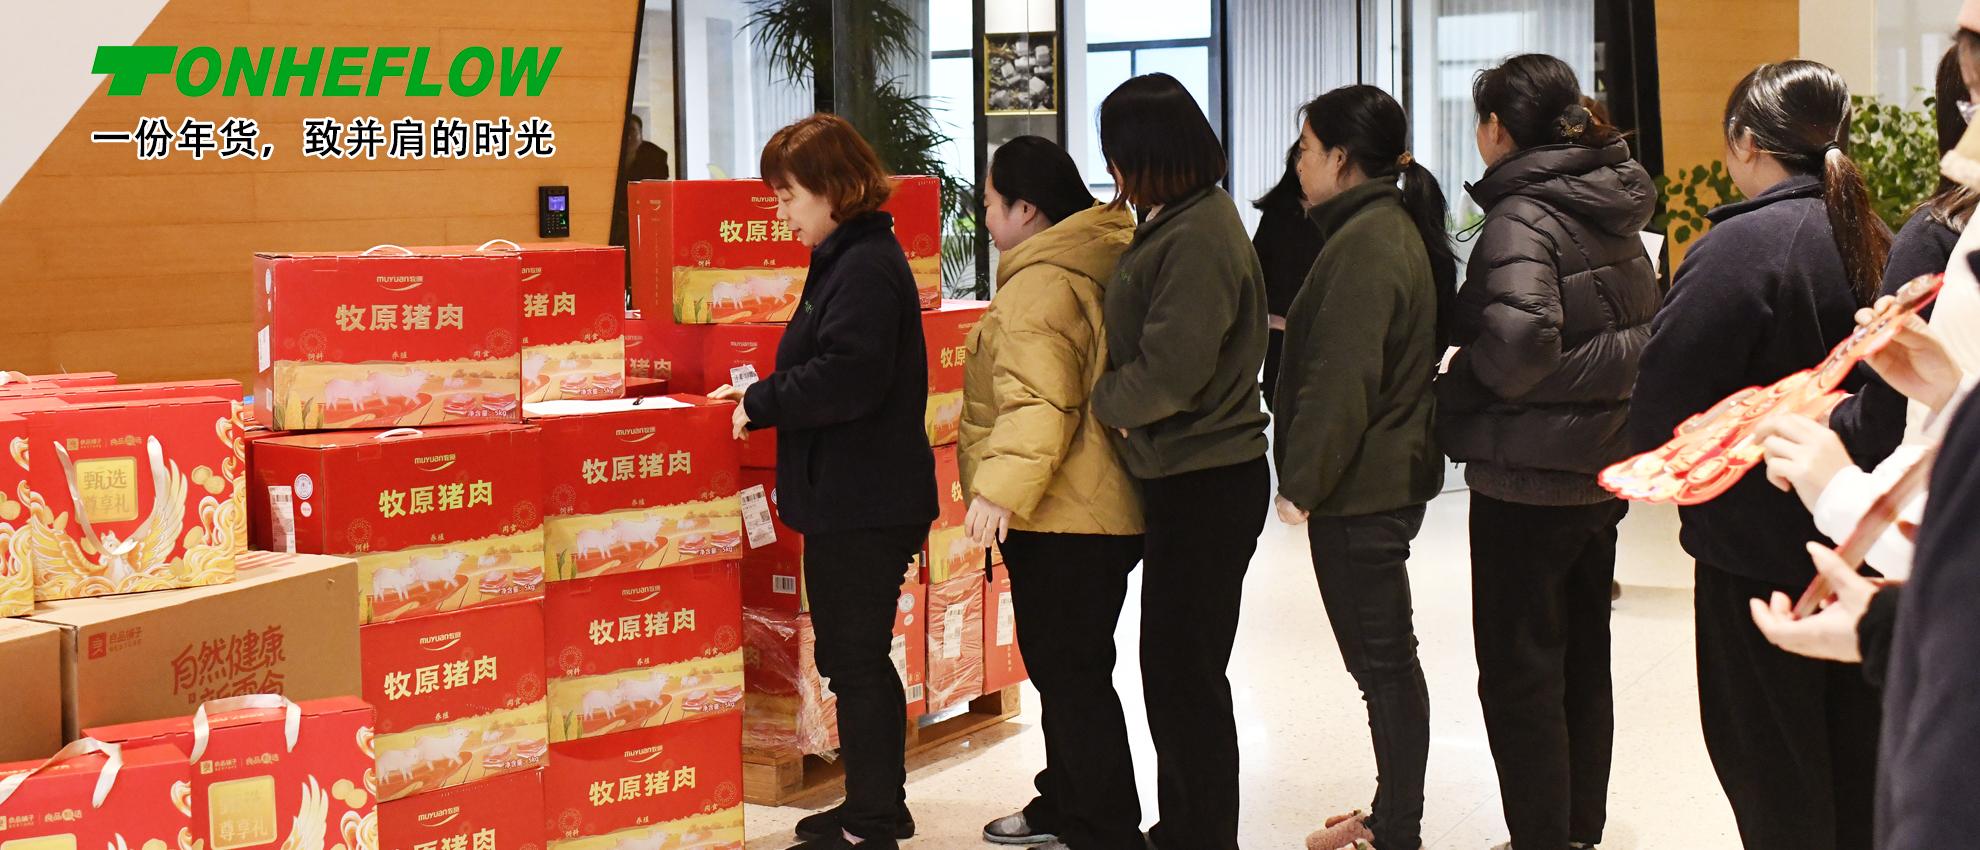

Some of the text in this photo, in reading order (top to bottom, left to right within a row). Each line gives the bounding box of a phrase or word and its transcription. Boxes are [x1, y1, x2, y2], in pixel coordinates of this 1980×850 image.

[719, 219, 800, 243] 牧原猪
[335, 303, 464, 332] 牧原猪肉
[523, 291, 576, 318] 猪肉
[629, 357, 672, 379] 猪肉
[941, 346, 966, 368] 牧原
[581, 450, 692, 485] 牧原猪肉
[378, 479, 493, 519] 牧原猪肉
[589, 607, 696, 646] 牧原猪肉
[170, 624, 286, 696] 自然健康
[383, 655, 497, 701] 牧原猪肉
[589, 765, 696, 806] 牧原猪肉
